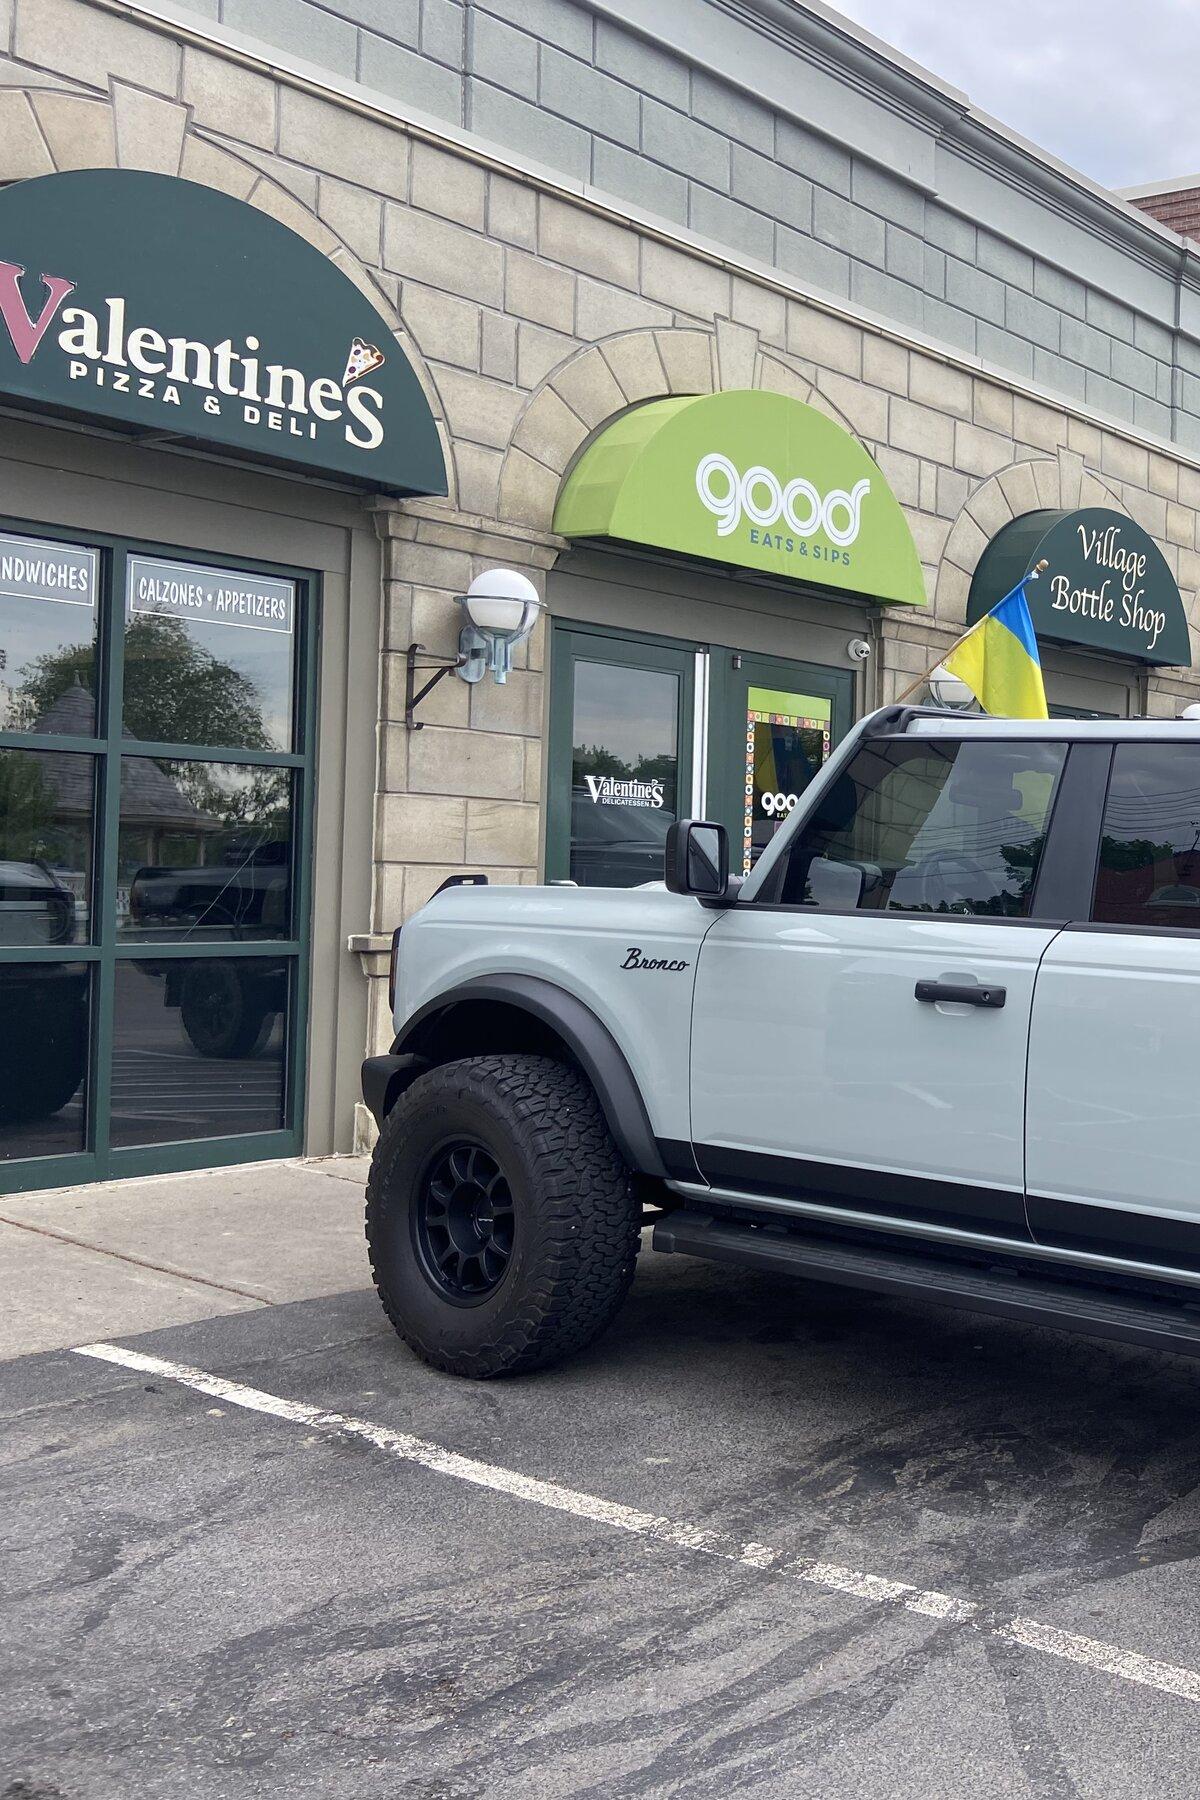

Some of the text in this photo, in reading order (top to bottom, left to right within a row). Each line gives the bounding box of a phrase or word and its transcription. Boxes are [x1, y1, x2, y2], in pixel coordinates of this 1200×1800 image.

[69, 360, 317, 440] PIZZA & DELI
[695, 453, 870, 547] good
[750, 529, 850, 566] EATS & SIPS
[1076, 524, 1146, 591] Village
[0, 555, 88, 592] NDWICHES
[139, 576, 286, 620] CALZONES APPETIZERS
[1050, 575, 1165, 650] Bottle Shop
[602, 797, 649, 807] DELICATESSEN
[761, 792, 800, 816] goo
[620, 947, 690, 971] Bronco
